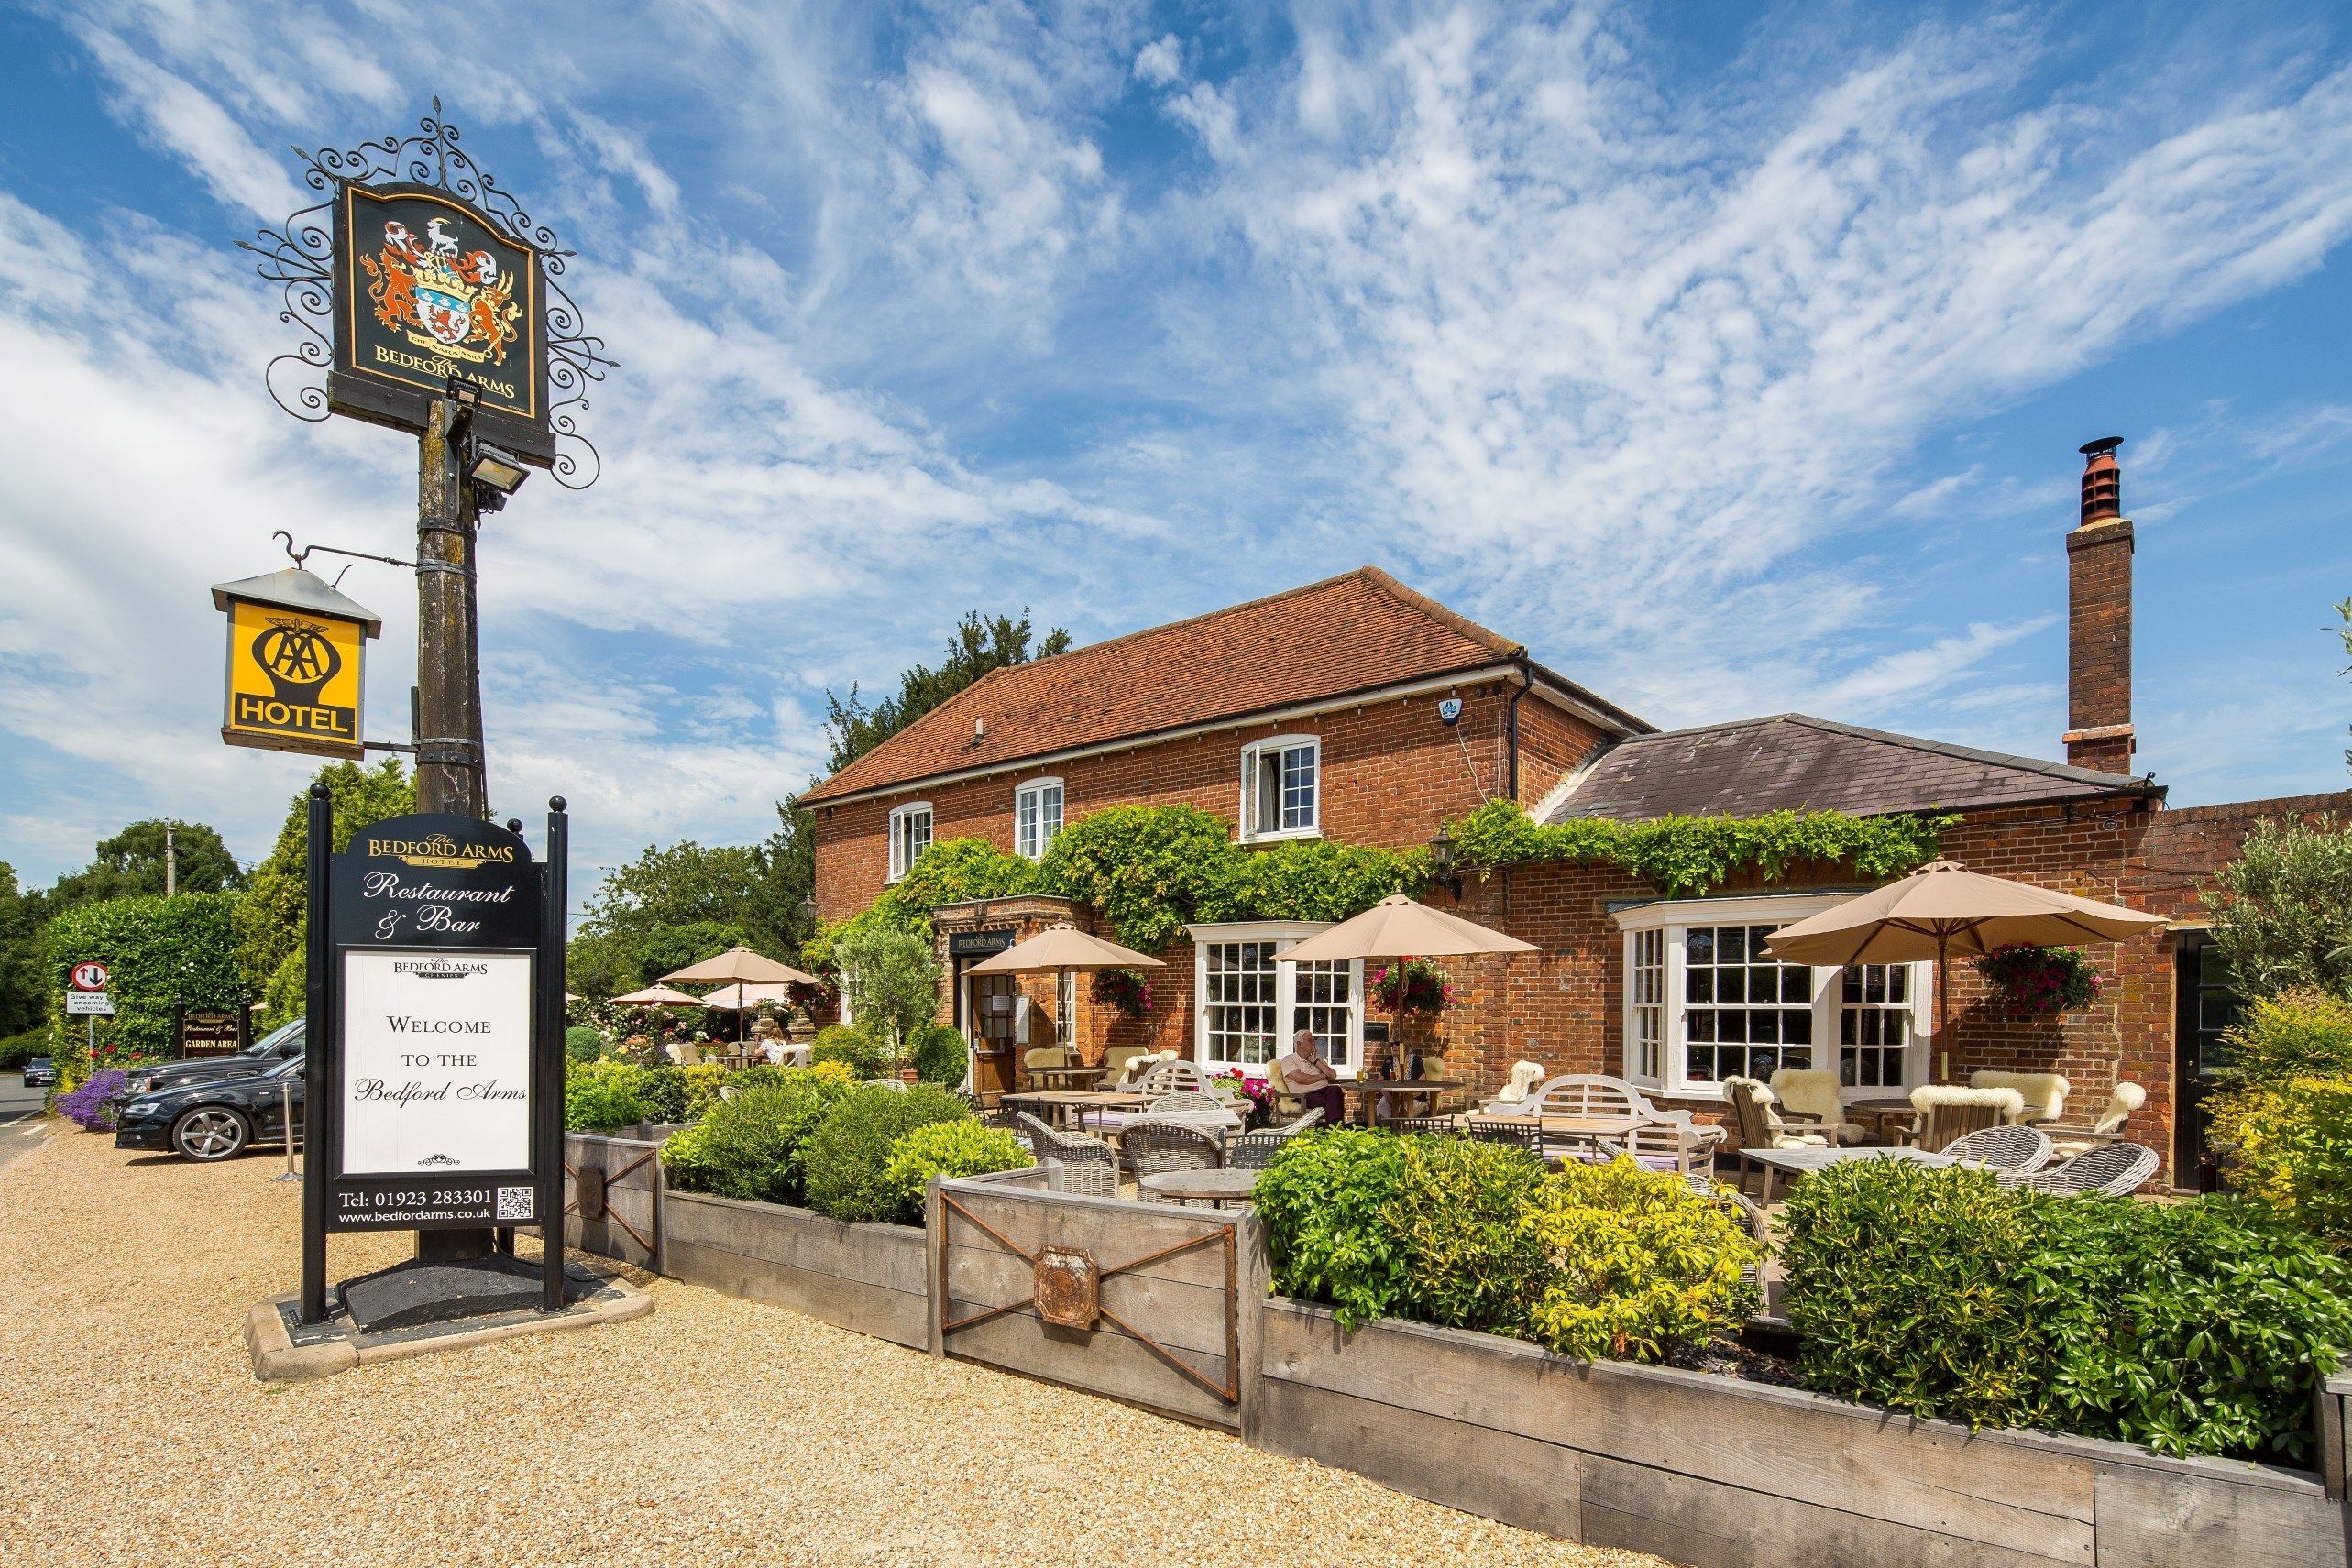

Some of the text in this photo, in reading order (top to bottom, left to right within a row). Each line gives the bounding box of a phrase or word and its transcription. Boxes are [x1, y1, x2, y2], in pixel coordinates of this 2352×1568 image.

[432, 345, 458, 356] SARA
[431, 356, 459, 368] The
[374, 345, 515, 399] BEDFORD ARMS
[241, 697, 348, 733] HOTEL
[426, 833, 454, 844] The
[368, 839, 513, 863] BEDFORD ARMS
[363, 872, 515, 903] Restaurant
[375, 905, 481, 939] & Bar
[394, 962, 488, 975] BEDFORD ARMS
[386, 1015, 492, 1034] WELCOME
[185, 1040, 237, 1048] GARDEN AREA
[401, 1054, 478, 1067] TO THE
[354, 1078, 527, 1109] Bedford Arms
[339, 1190, 491, 1207] Tel: 01923 283301
[339, 1208, 490, 1223] www.bedfordarms.co.uk
